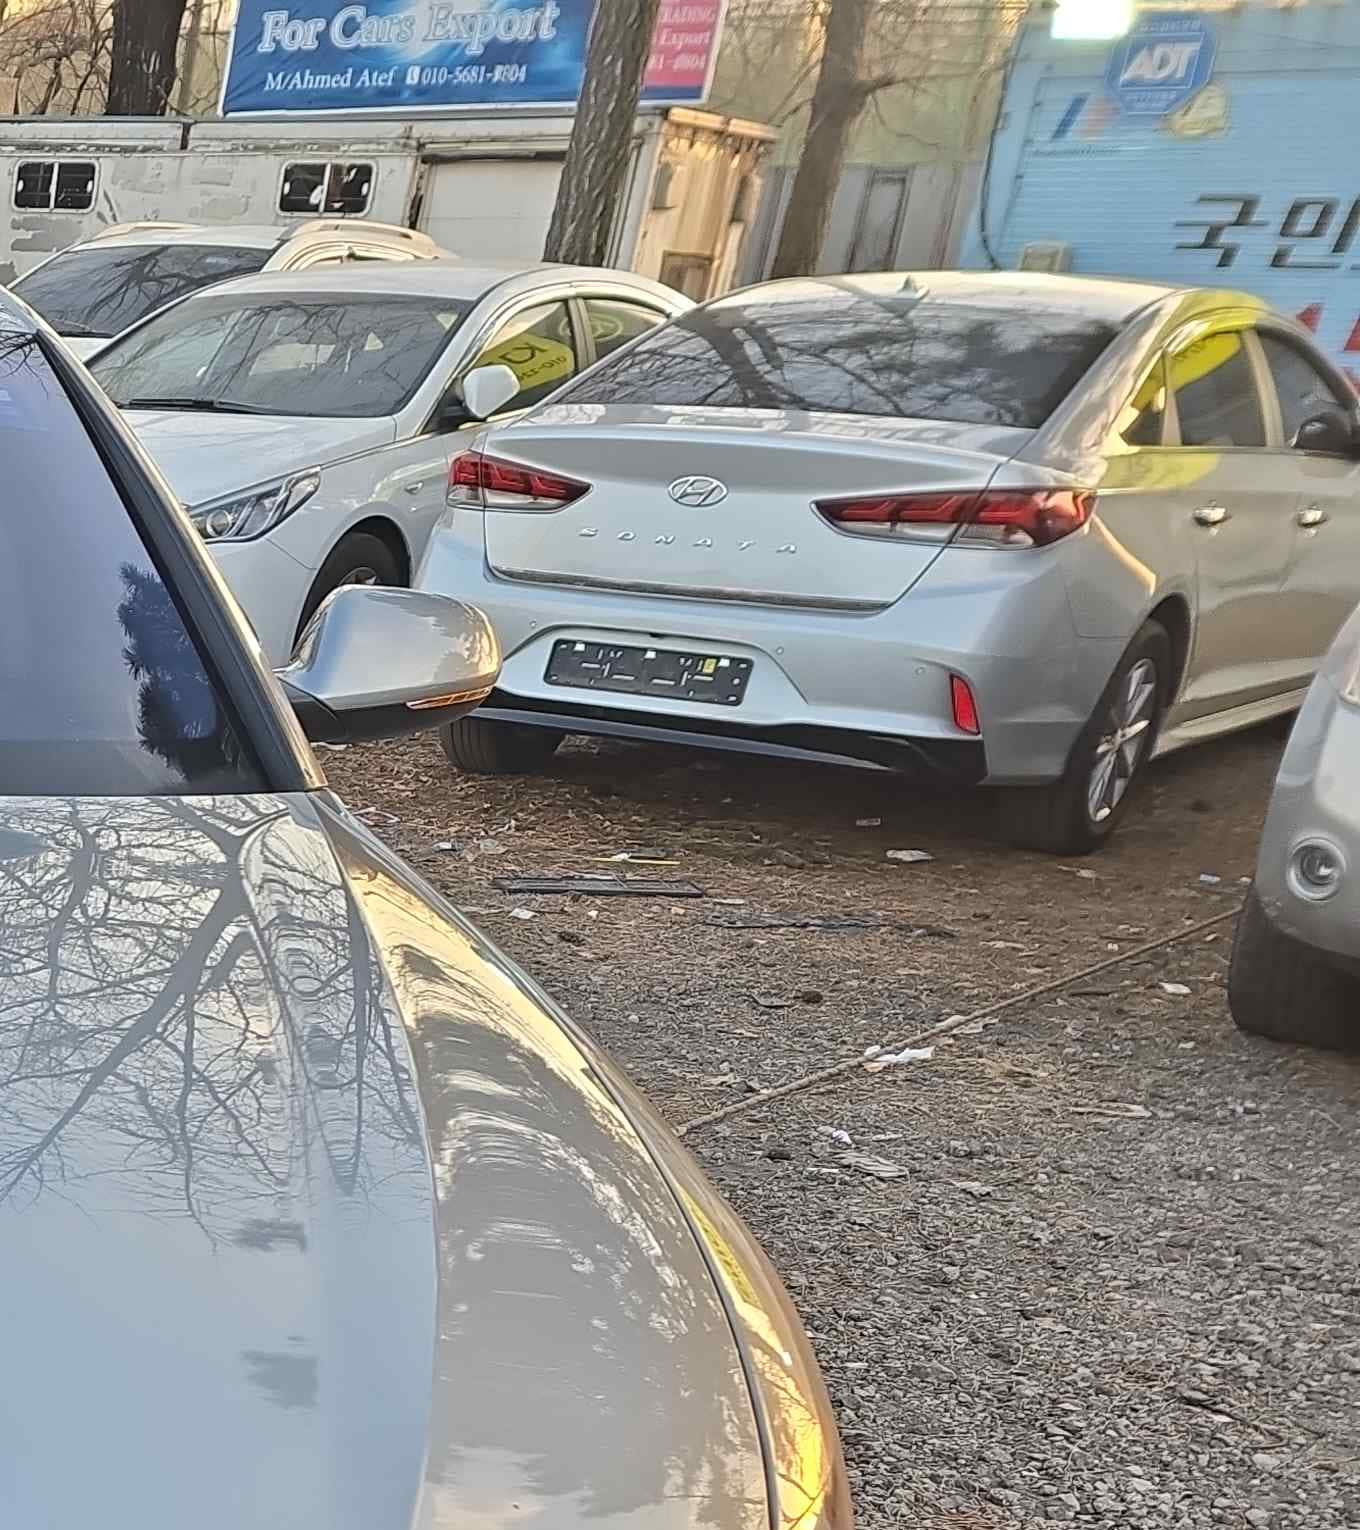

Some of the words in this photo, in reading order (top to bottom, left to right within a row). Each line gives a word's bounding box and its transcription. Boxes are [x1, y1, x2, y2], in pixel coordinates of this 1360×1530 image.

[257, 9, 326, 54] For
[331, 6, 416, 50] Cars
[423, 1, 556, 54] Export
[1119, 42, 1203, 80] ADT
[264, 68, 352, 91] M/Ahmed
[357, 66, 397, 88] Atef
[580, 526, 797, 554] SONATA
